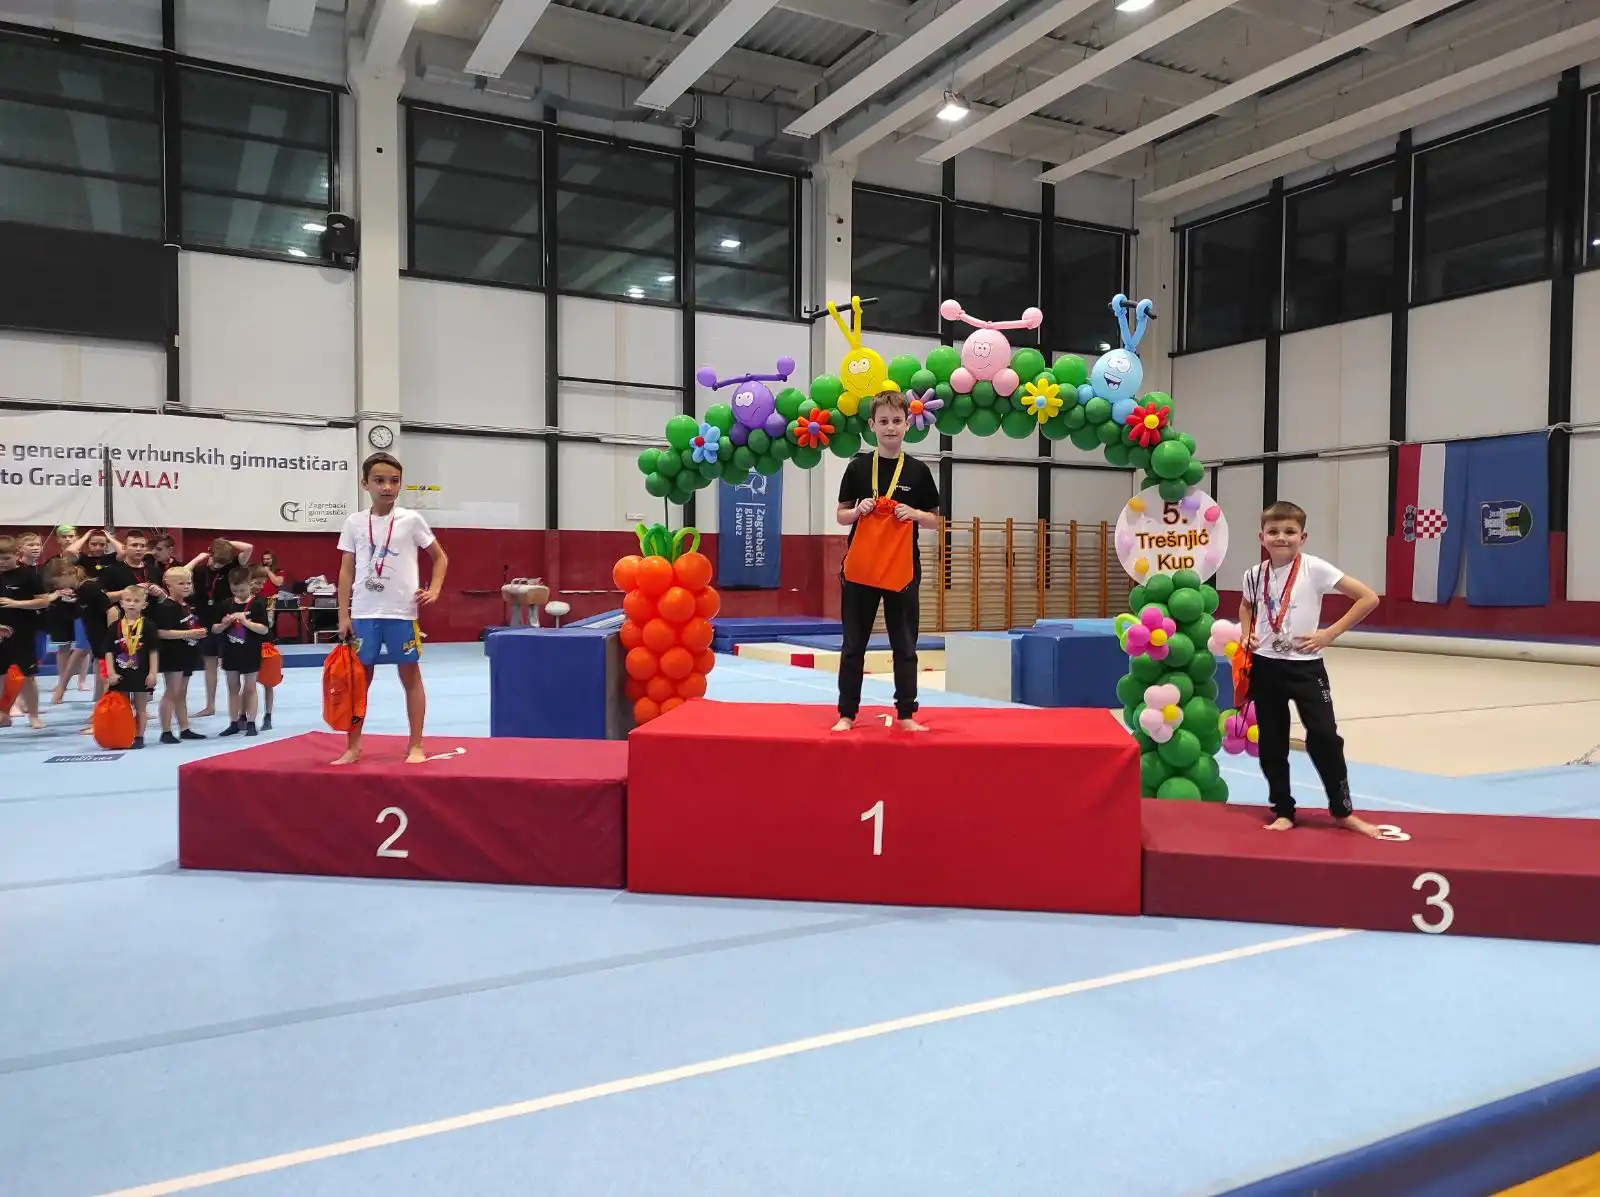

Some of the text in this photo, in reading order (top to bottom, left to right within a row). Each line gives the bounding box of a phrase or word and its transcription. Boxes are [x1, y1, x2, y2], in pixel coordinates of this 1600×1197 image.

[12, 443, 122, 461] generacie
[127, 443, 225, 465] vrhunskih
[229, 450, 348, 471] gimnastičara
[29, 467, 92, 487] Grade
[735, 507, 743, 536] savez
[1163, 502, 1188, 524] 5.
[744, 508, 754, 567] gimnastički
[754, 508, 766, 566] Zagrebački
[1135, 528, 1209, 550] Trešnjić
[1157, 554, 1195, 570] Kup
[375, 806, 409, 858] 2
[860, 800, 884, 856] 1
[1411, 871, 1455, 934] 3
